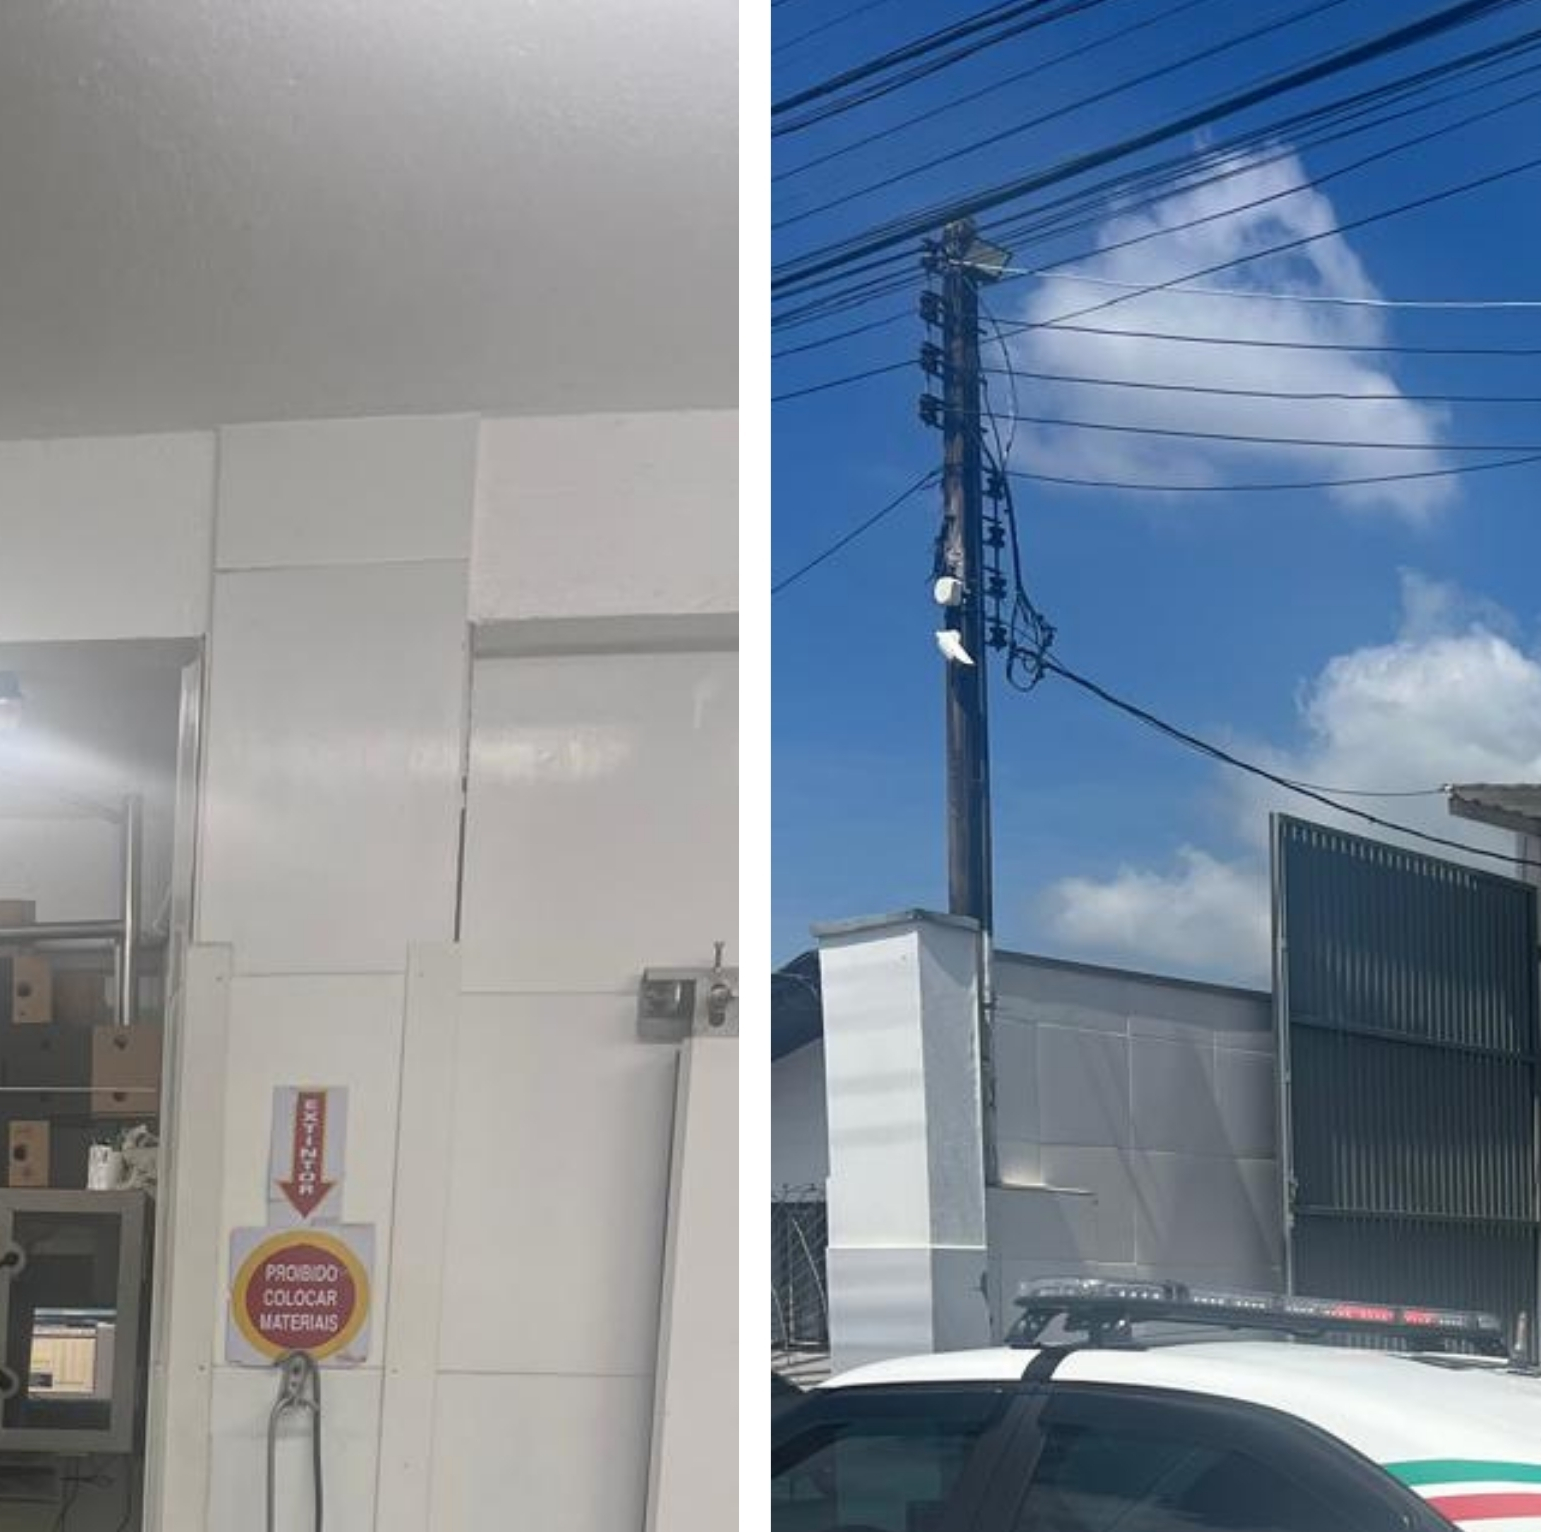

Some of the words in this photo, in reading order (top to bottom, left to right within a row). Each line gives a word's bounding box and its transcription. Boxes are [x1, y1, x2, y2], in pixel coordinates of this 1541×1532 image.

[298, 1099, 319, 1195] EXTINTOR
[264, 1264, 339, 1282] PROIBIDO
[262, 1288, 338, 1307] COLOCAR
[259, 1313, 339, 1332] MATERIAIS
